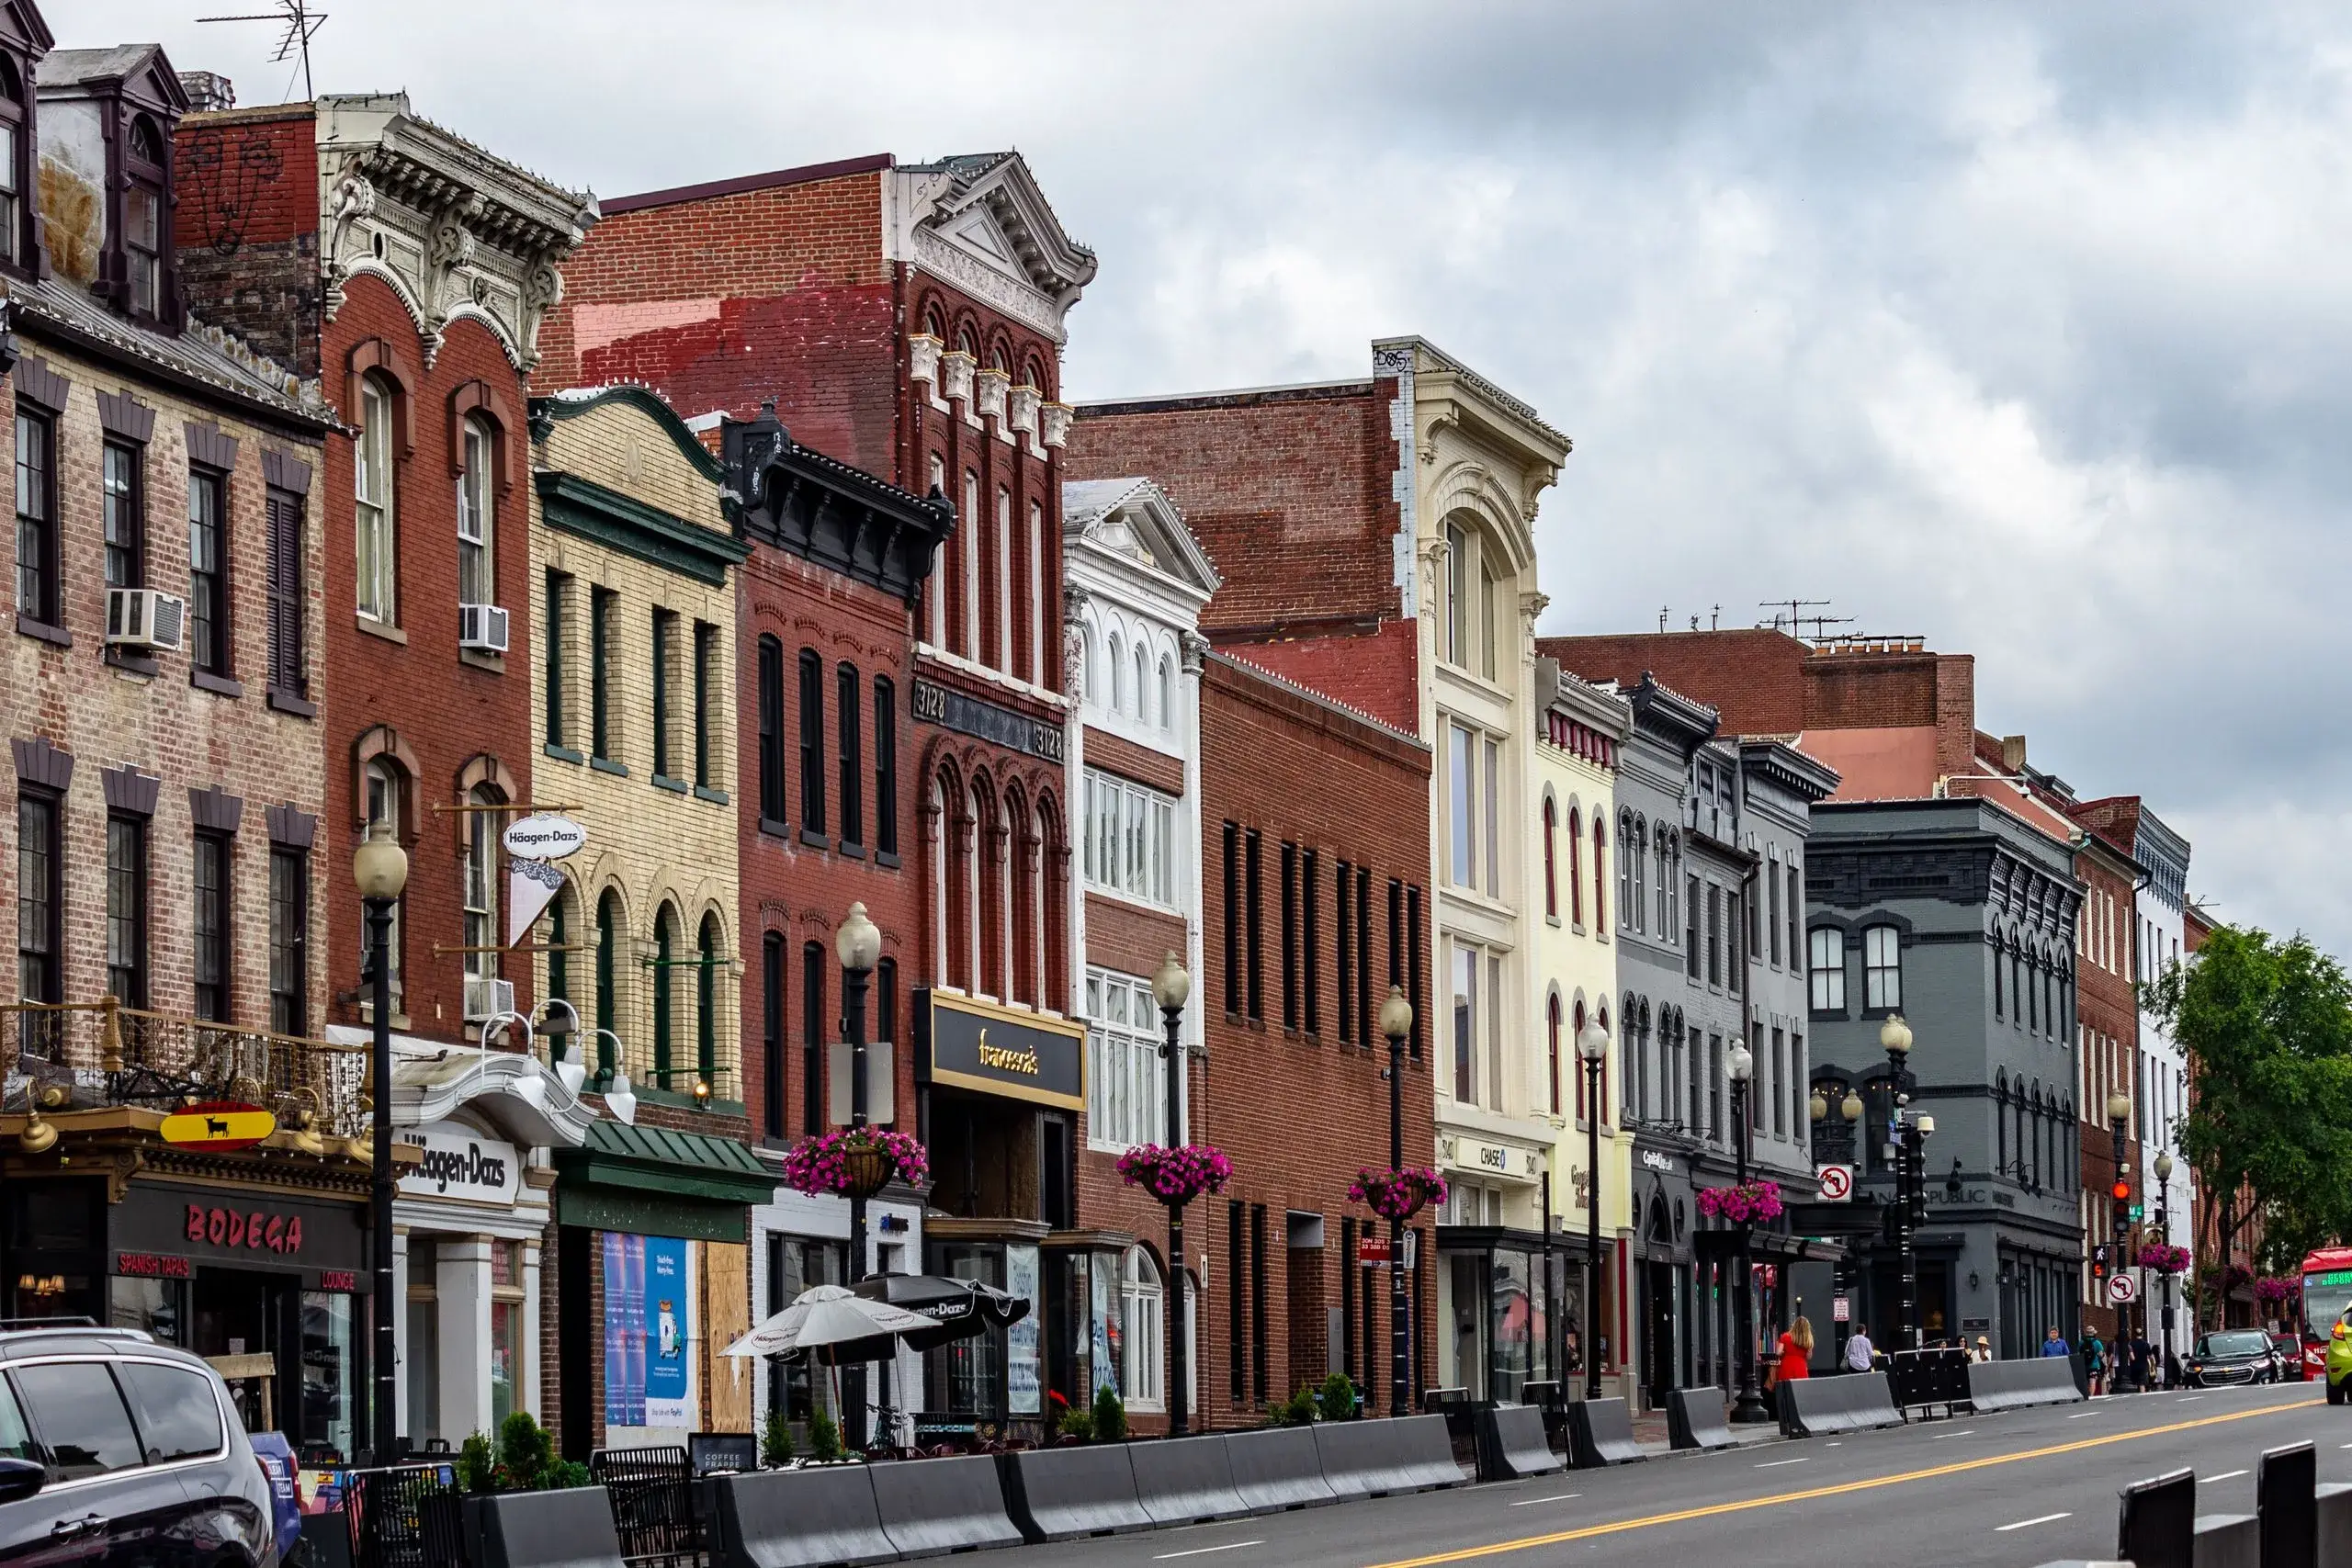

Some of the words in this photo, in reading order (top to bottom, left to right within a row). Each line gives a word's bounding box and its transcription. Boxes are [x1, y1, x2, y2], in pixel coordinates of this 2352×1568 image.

[919, 685, 944, 718] 3128
[1037, 727, 1063, 759] 3128
[509, 830, 579, 845] Häagen-Dazs
[1480, 1147, 1500, 1168] CHASE
[187, 1204, 302, 1254] BODEGA
[119, 1254, 159, 1274] SPANISH
[161, 1257, 189, 1277] TAPAS
[322, 1270, 355, 1291] LOUNGE
[705, 1453, 741, 1461] COFFEE
[277, 1482, 291, 1494] TEAM
